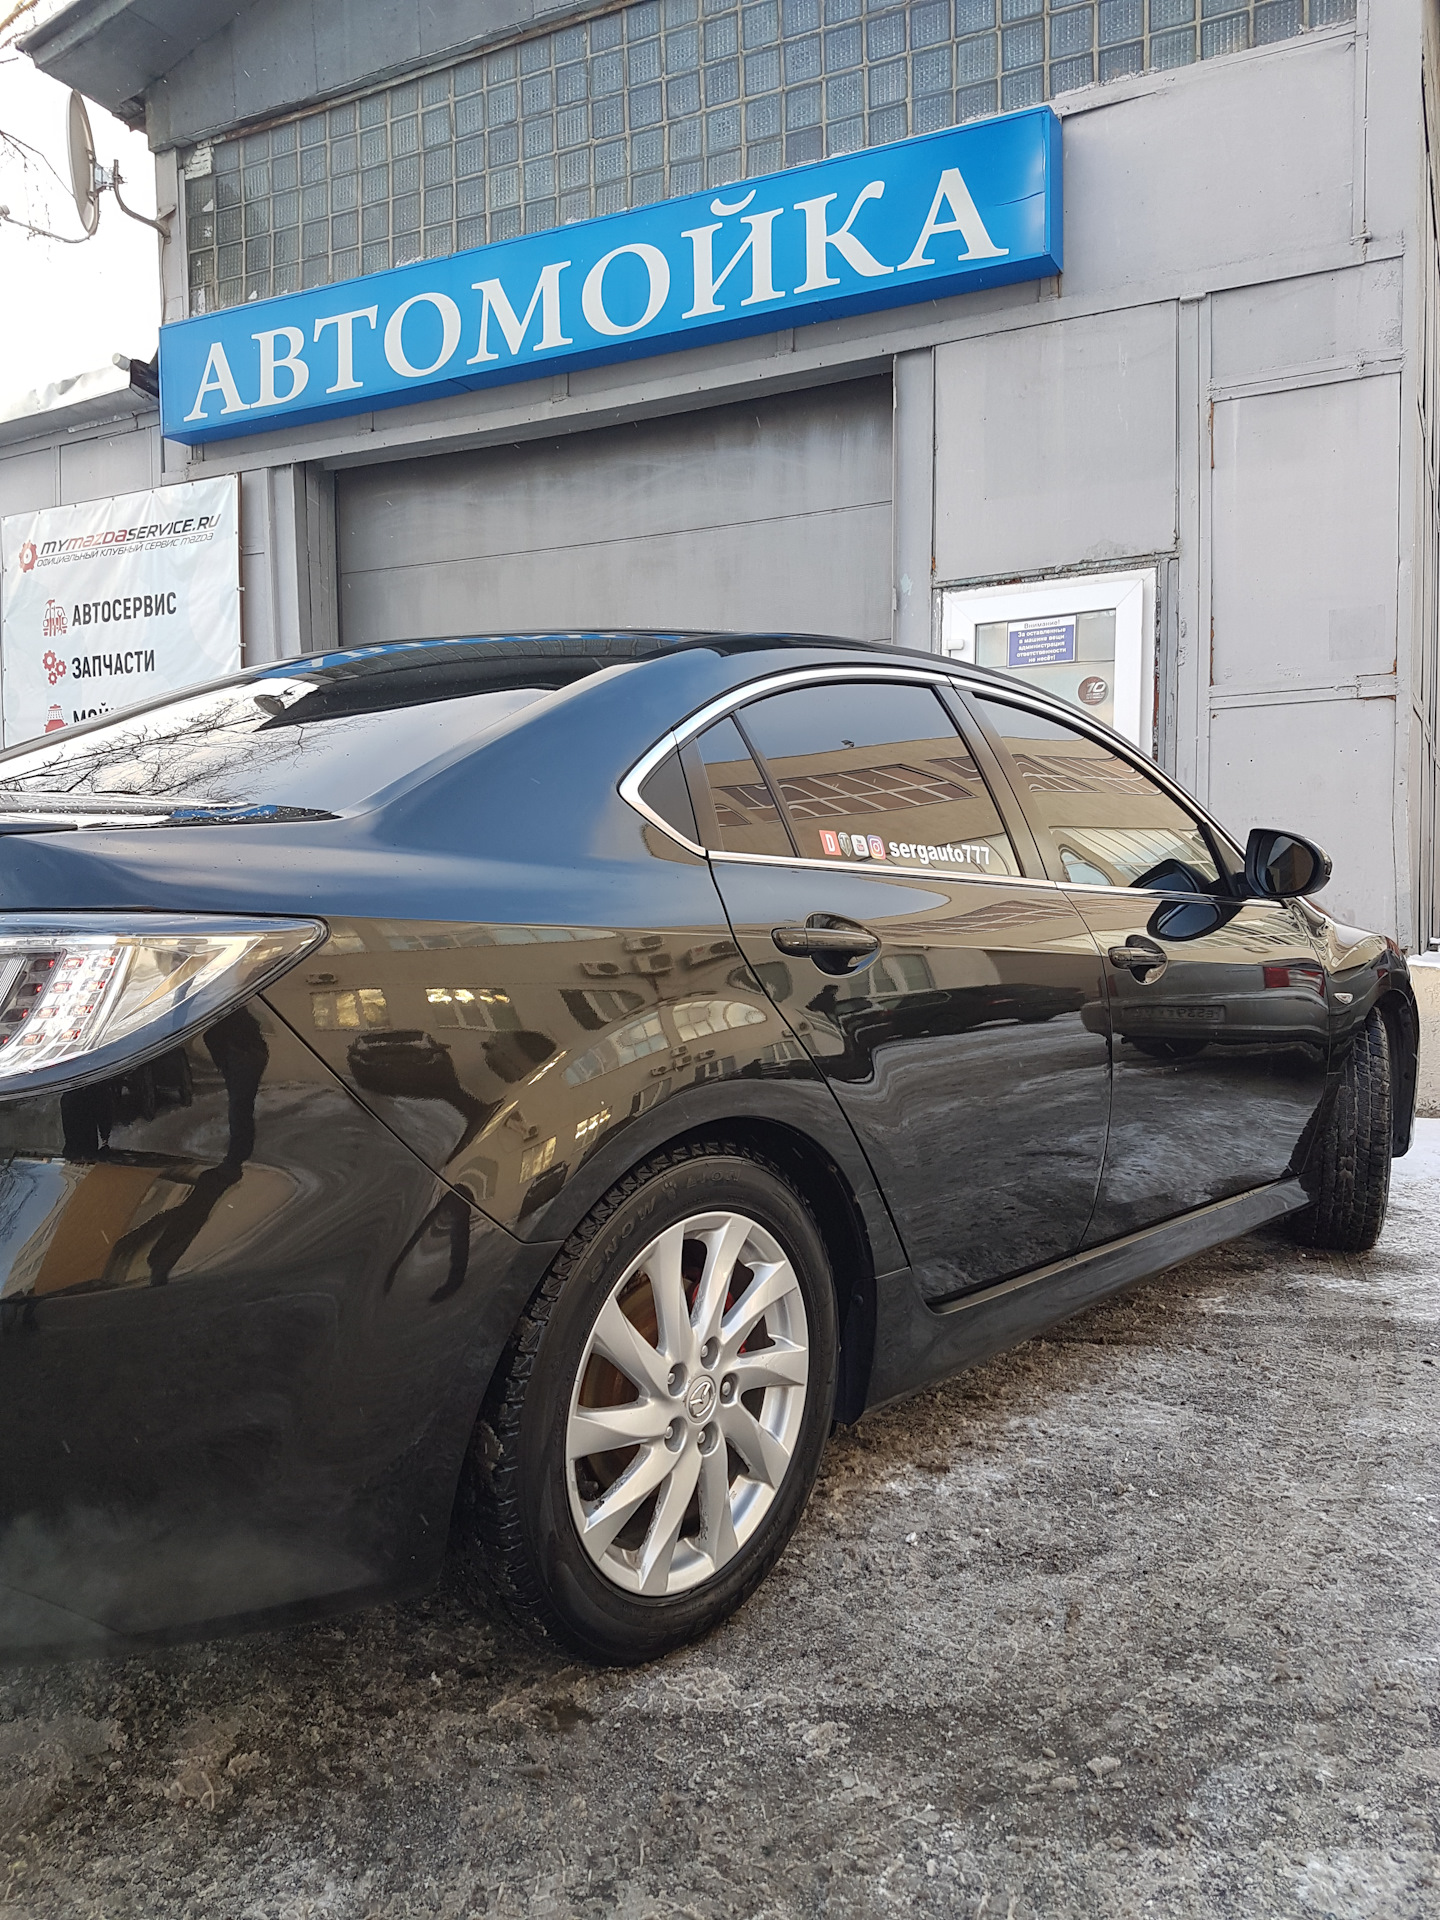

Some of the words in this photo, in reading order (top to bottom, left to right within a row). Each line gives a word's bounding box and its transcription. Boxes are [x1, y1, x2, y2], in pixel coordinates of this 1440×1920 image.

[184, 168, 1010, 423] АВТОМОЙКА
[99, 541, 144, 557] КЛУБНЫЙ
[144, 538, 178, 551] СЕРВИС
[72, 592, 177, 627] АВТОСЕРВИС
[1024, 620, 1060, 629] Внимание!
[71, 650, 155, 679] ЗАПЧАСТИ
[1086, 681, 1106, 693] 10
[889, 841, 990, 864] sergauto777
